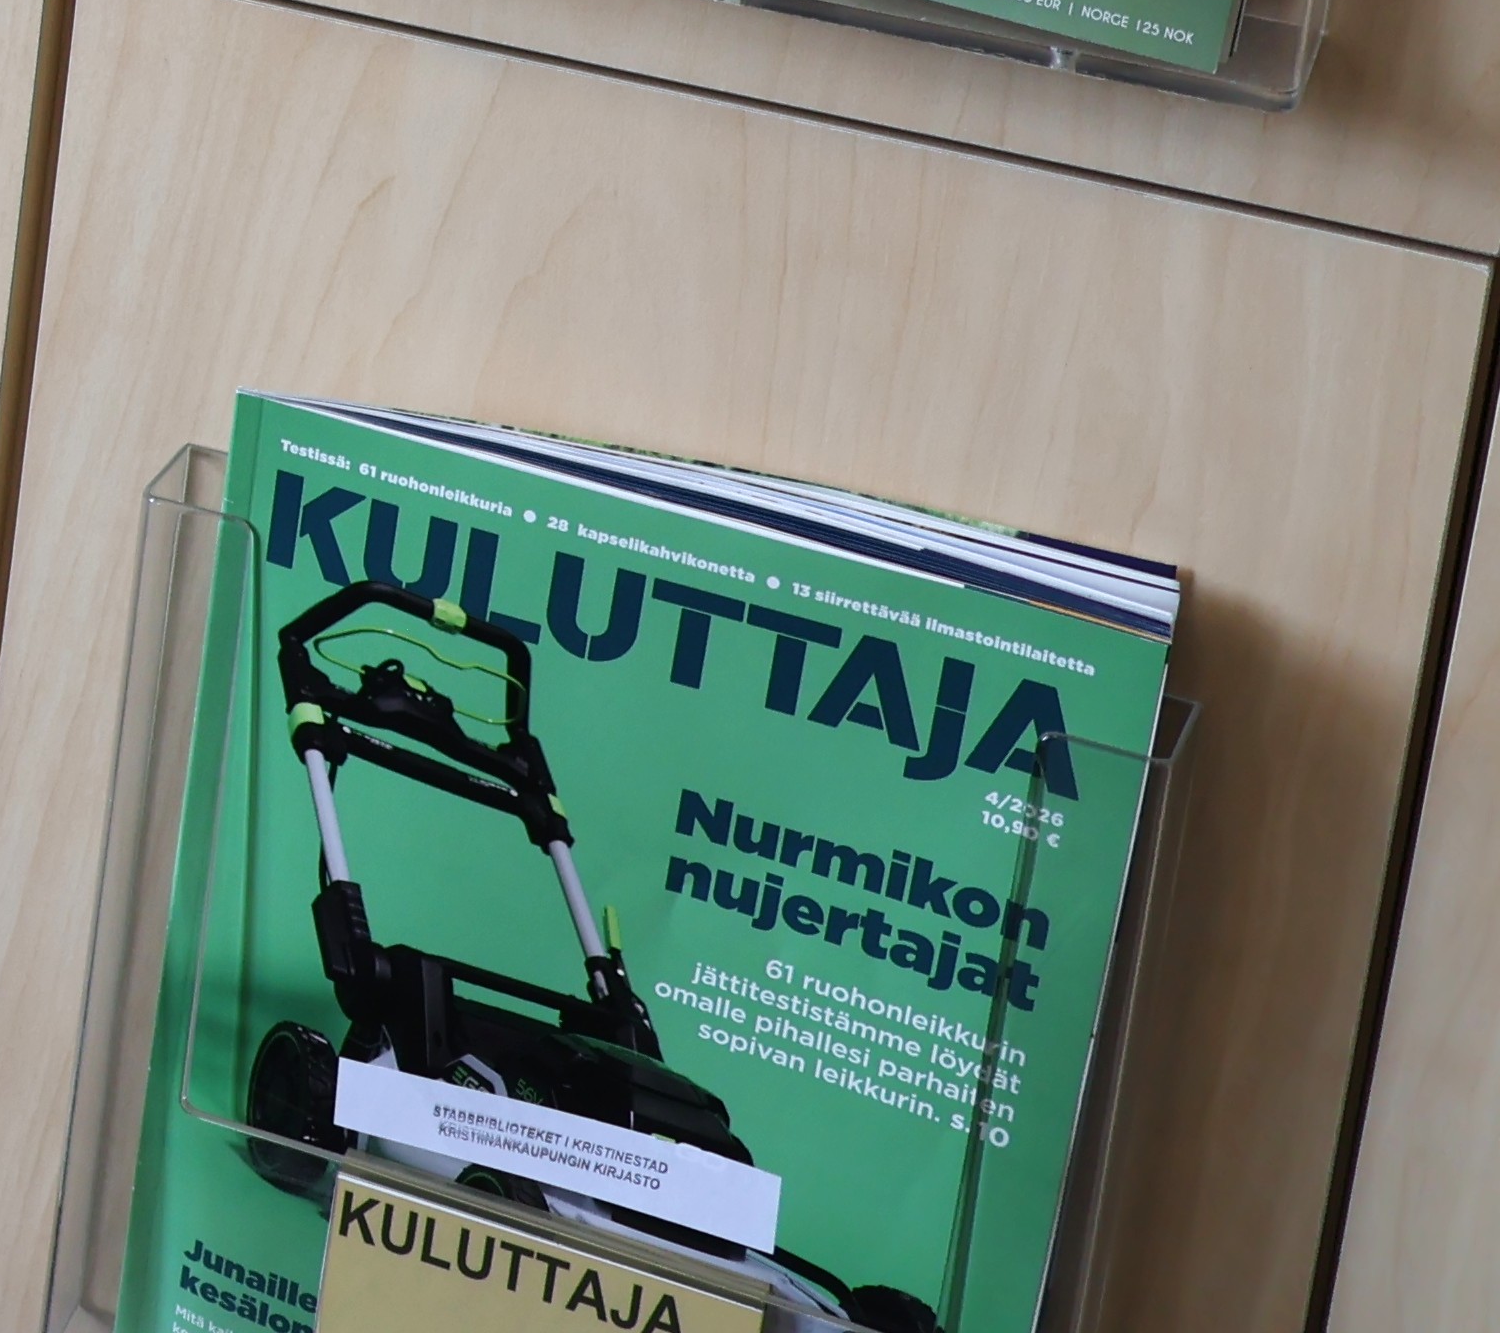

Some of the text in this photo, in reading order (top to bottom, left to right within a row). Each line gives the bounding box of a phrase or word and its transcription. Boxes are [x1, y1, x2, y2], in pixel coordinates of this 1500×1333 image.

[264, 469, 1081, 803] KULUTTAJA
[280, 438, 1096, 677] Testissä: 61 ruohonleikkuria 28 kapselikahvikonetta 13 siirrettävää ilmastointilaitetta
[663, 854, 1039, 1013] nujertajat
[675, 790, 1051, 951] Nurmikon
[338, 1191, 682, 1333] KULUTTAJA
